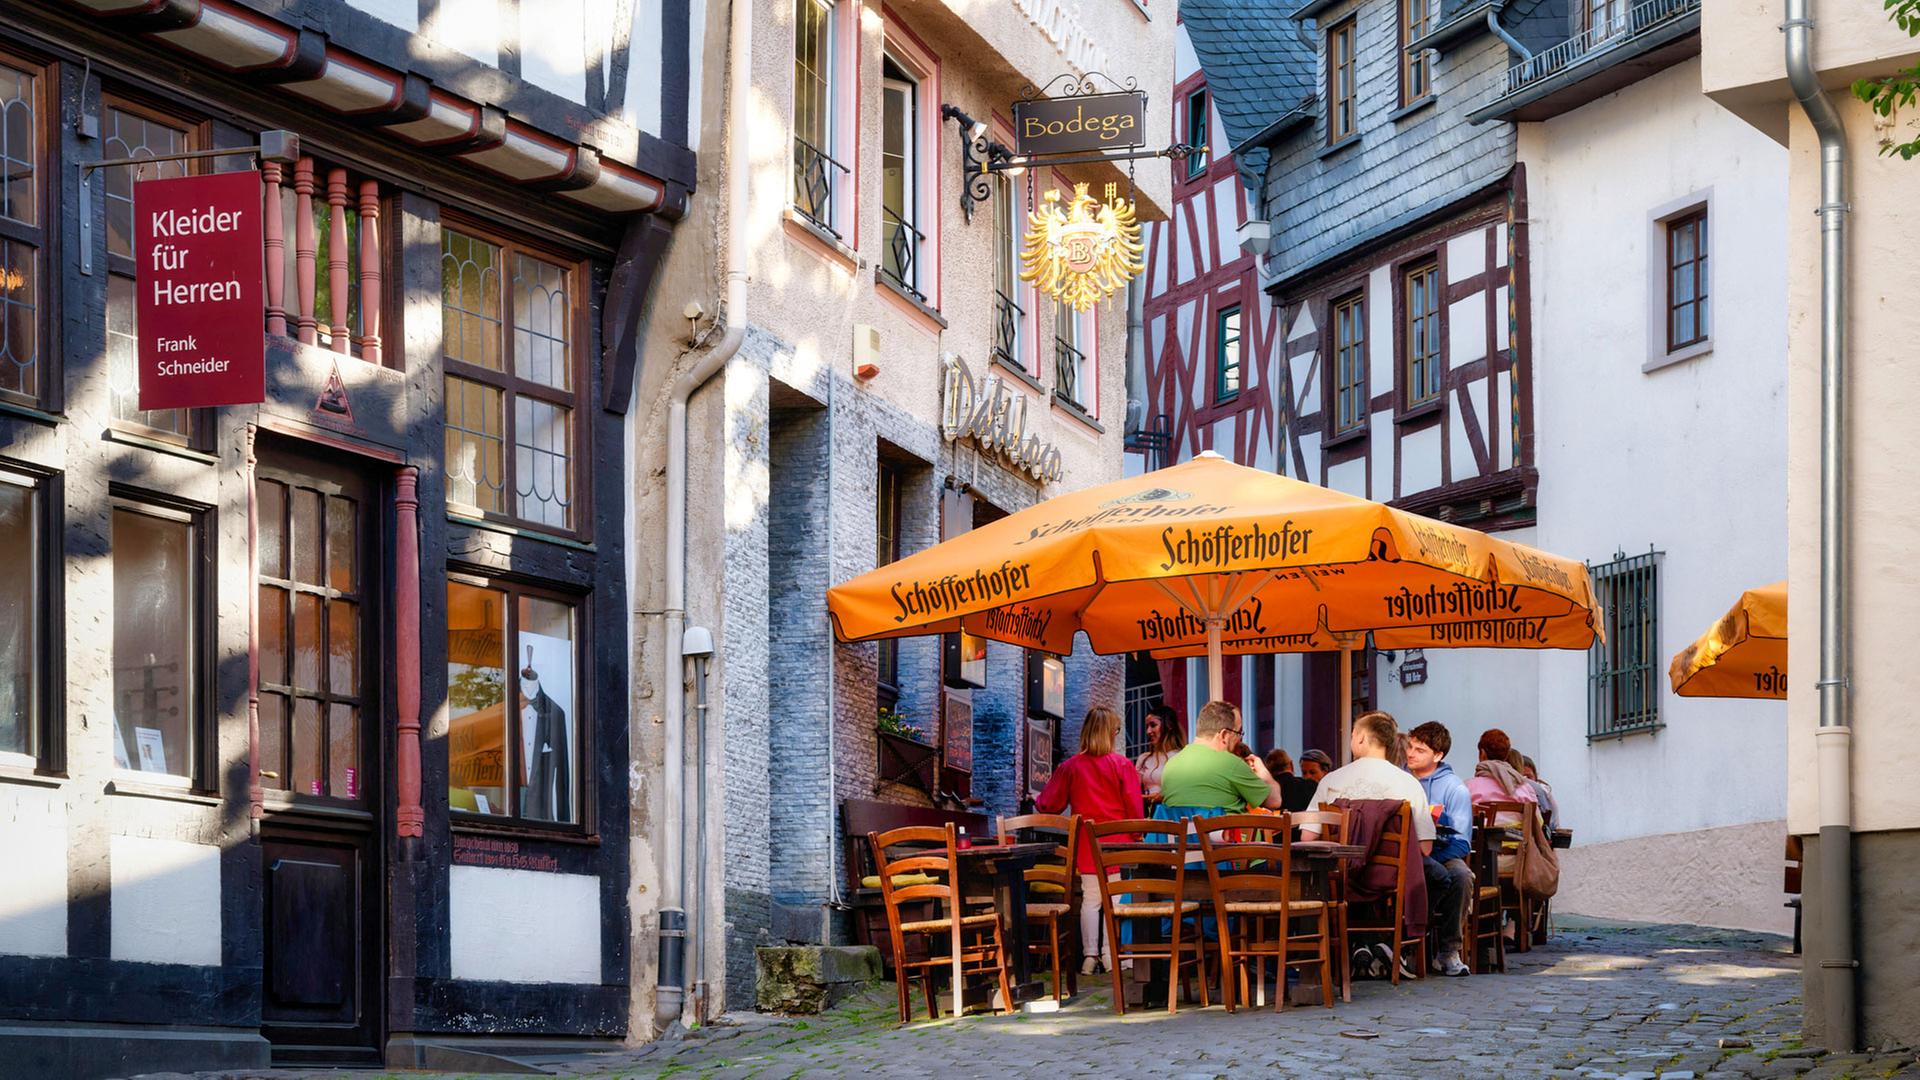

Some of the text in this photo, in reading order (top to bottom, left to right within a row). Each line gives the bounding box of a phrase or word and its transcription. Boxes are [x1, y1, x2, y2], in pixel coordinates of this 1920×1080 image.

[1024, 105, 1134, 140] Bodega
[152, 206, 242, 238] Kleider
[152, 243, 189, 271] für
[153, 279, 241, 306] Herren
[157, 335, 197, 352] Frank
[157, 357, 230, 376] Schneider
[1160, 519, 1313, 572] Schöfferhofer
[890, 560, 1030, 623] Schöfferhofer
